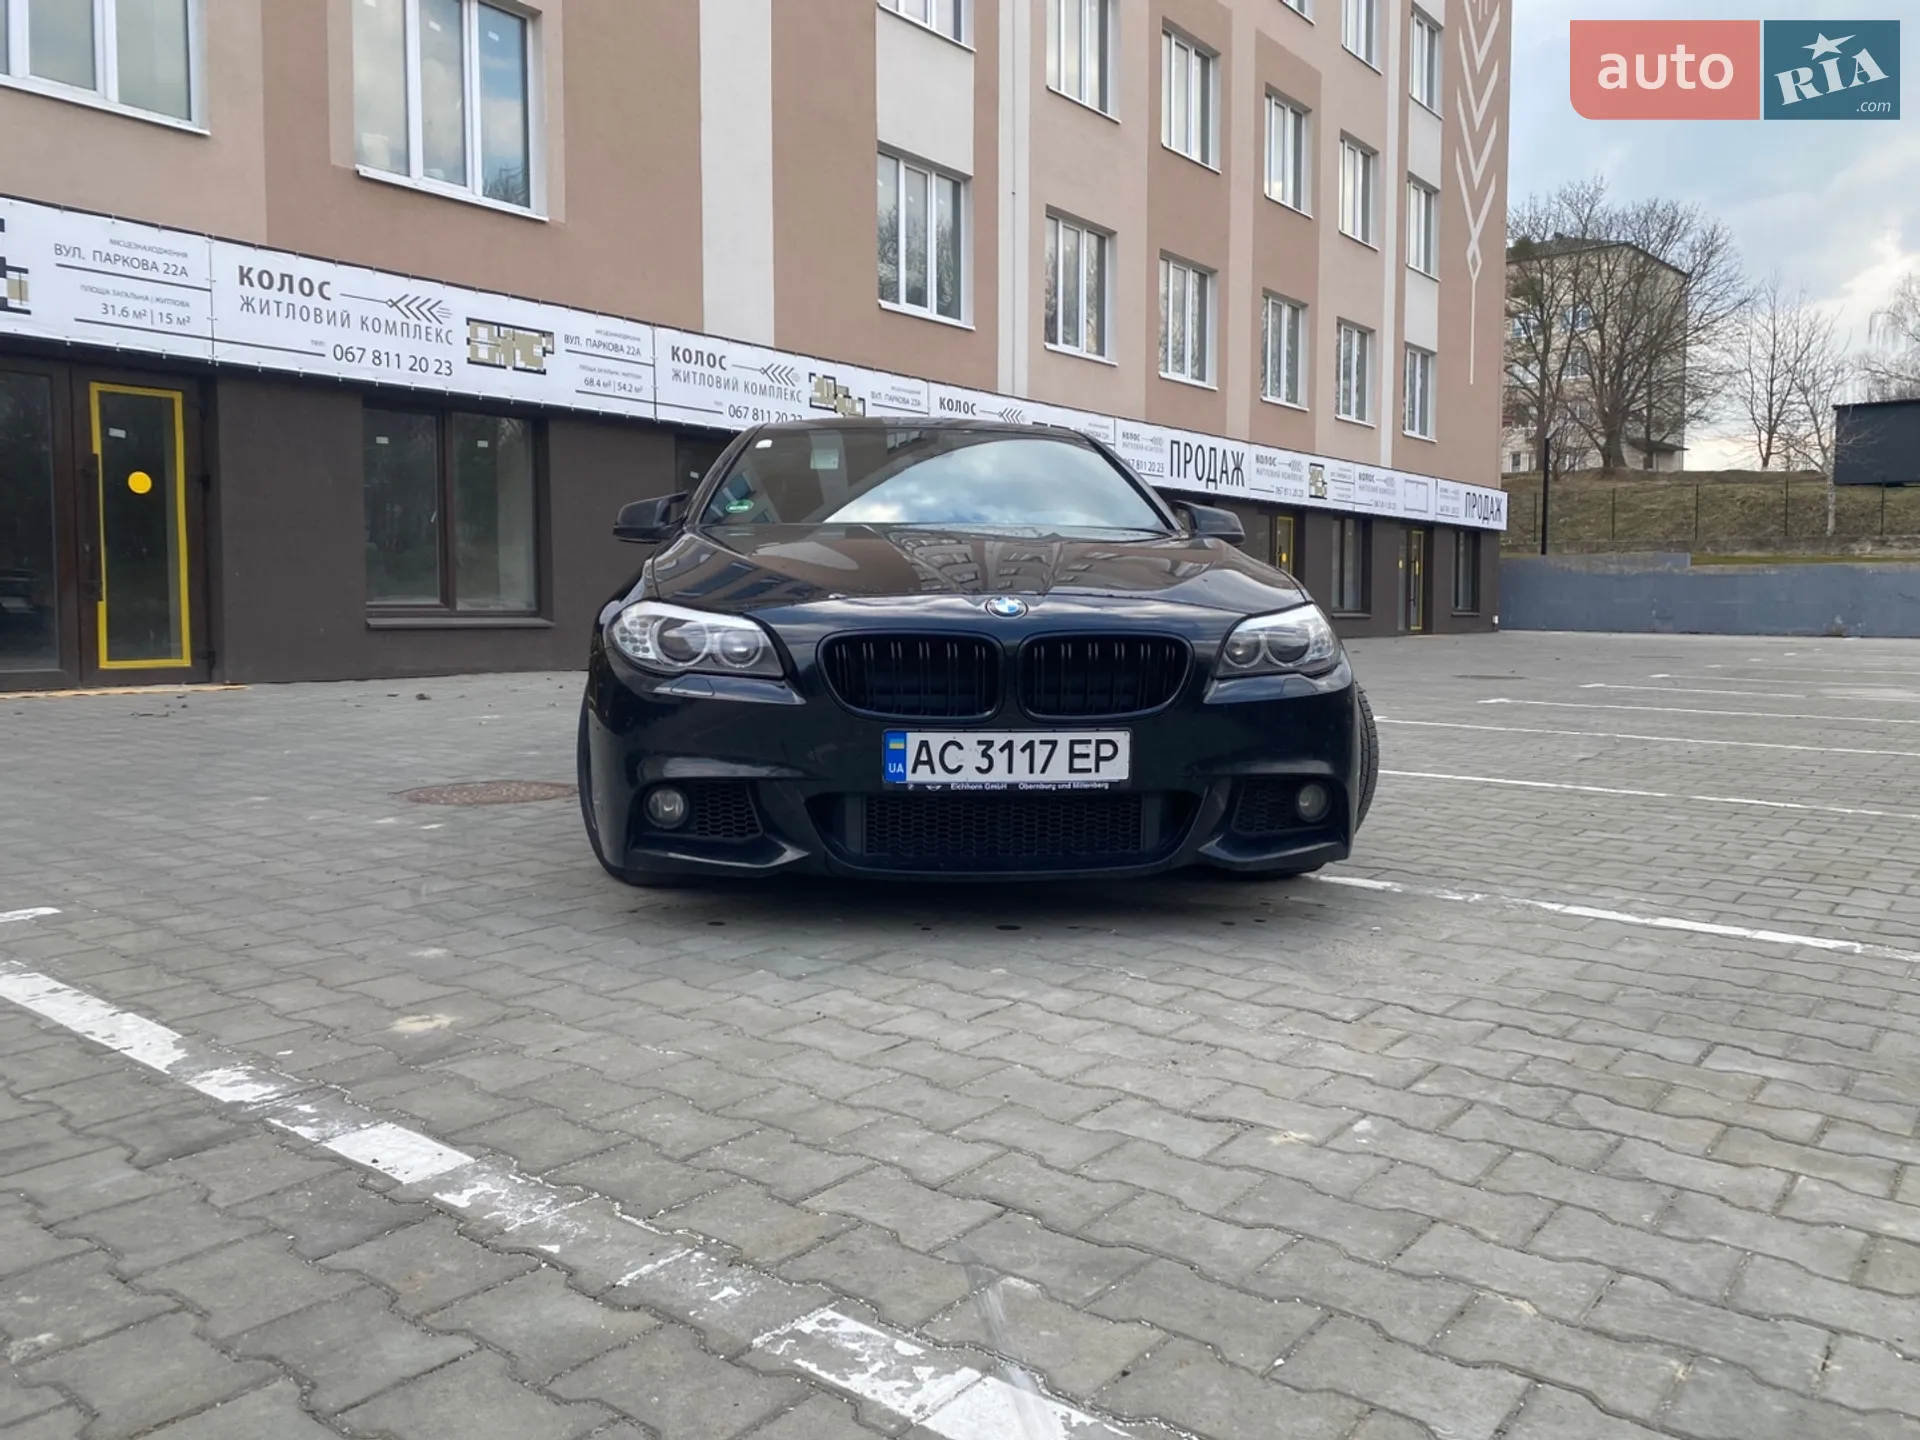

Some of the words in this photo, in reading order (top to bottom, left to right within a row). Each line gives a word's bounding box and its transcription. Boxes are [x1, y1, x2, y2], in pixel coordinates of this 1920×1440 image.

[54, 243, 85, 260] ВУЛ.
[92, 250, 159, 273] ПАРКОВА
[162, 262, 188, 278] 22А
[238, 265, 331, 301] КОЛОС
[101, 303, 129, 319] 31.6
[158, 312, 173, 325] 15
[240, 295, 351, 329] ЖИТЛОВИЙ
[360, 315, 453, 346] КОМПЛЕКС
[564, 334, 582, 346] ВУЛ.
[585, 338, 625, 353] ПАРКОВА
[626, 345, 642, 357] 22А
[671, 345, 727, 371] КОЛОС
[333, 344, 366, 363] 067
[372, 349, 401, 369] 811
[408, 355, 429, 373] 20
[434, 359, 453, 377] 23
[671, 368, 739, 393] ЖИТЛОВИЙ
[743, 381, 802, 403] КОМПЛЕКС
[728, 404, 749, 419] 067
[752, 407, 771, 422] 811
[939, 396, 977, 415] КОЛОС
[1122, 432, 1140, 441] КОЛОС
[1148, 461, 1156, 472] 20
[1156, 462, 1164, 473] 23
[1170, 440, 1245, 490] ПРОДАЖ
[1465, 492, 1503, 525] ПРОДАЖ
[888, 763, 904, 774] UA
[911, 740, 964, 774] AC
[974, 739, 1058, 774] 3117
[1068, 739, 1119, 774] EP
[1018, 782, 1056, 791] Obernburg
